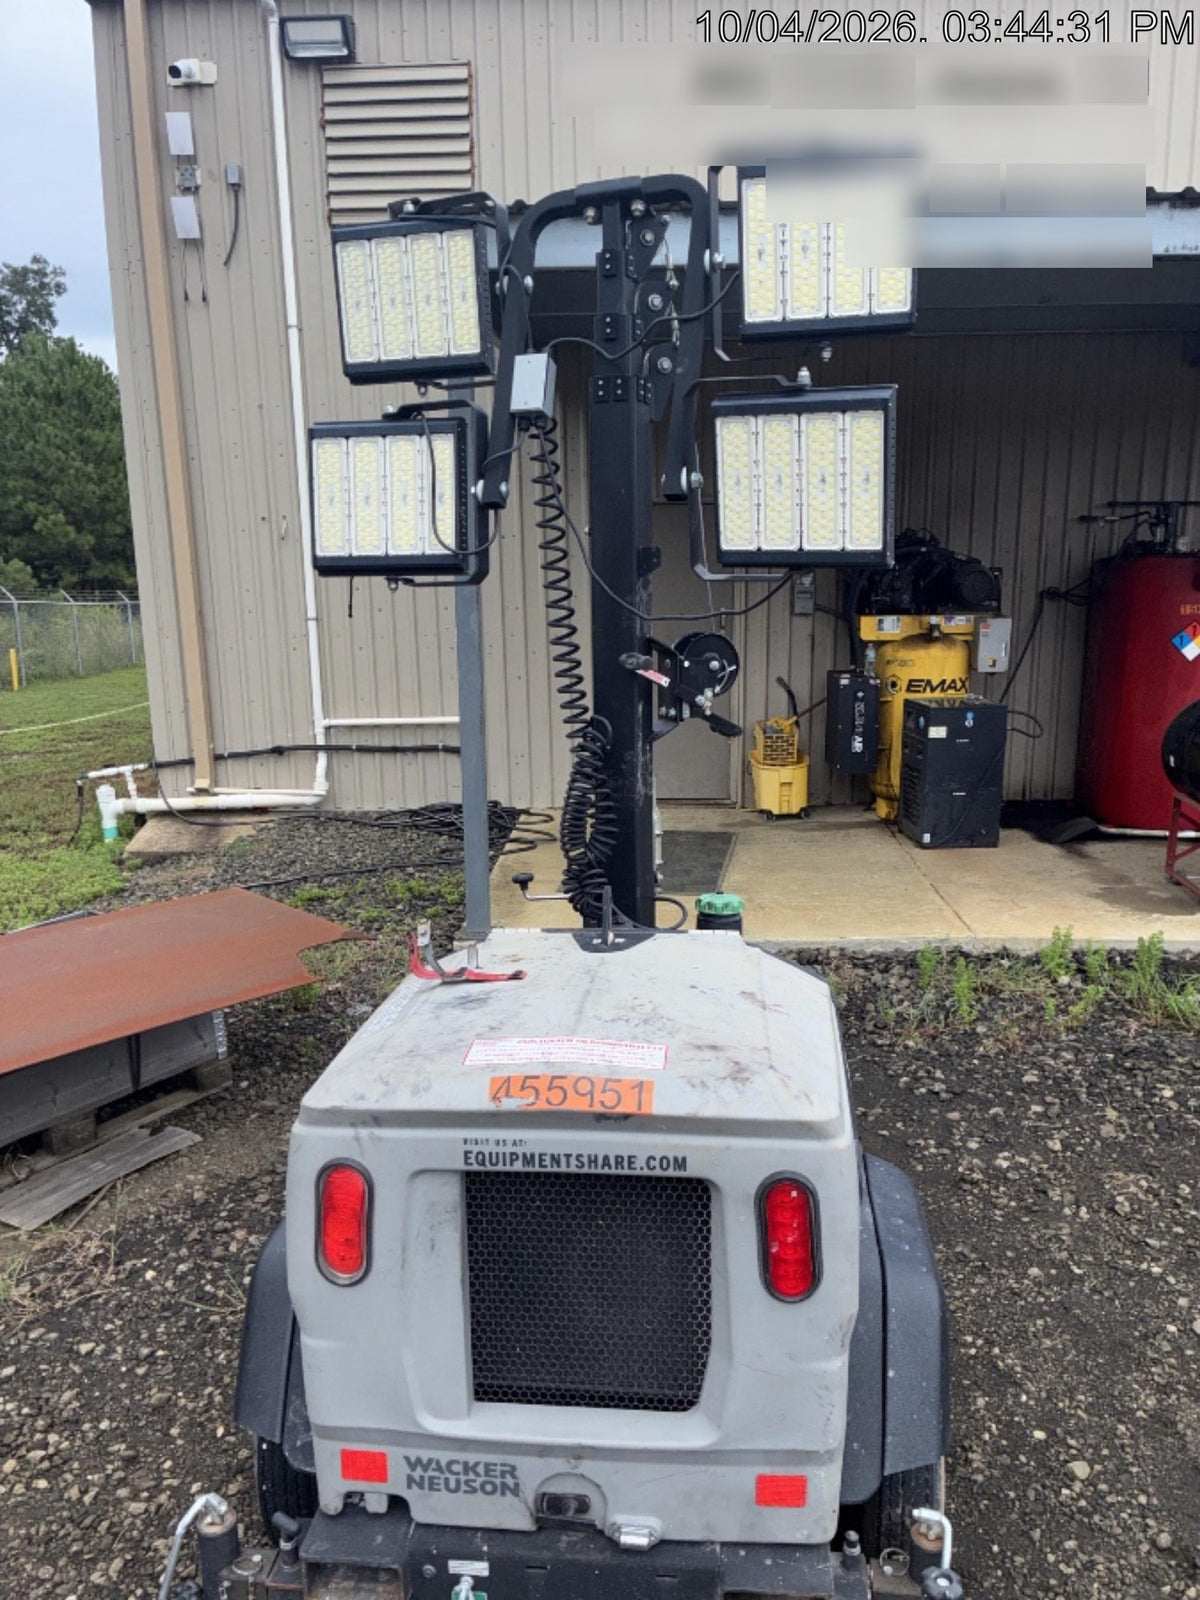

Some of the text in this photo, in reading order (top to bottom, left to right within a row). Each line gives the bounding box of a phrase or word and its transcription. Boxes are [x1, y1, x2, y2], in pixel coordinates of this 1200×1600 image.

[905, 677, 968, 693] EMAX
[492, 1075, 644, 1111] 455951
[463, 1138, 489, 1146] VISIT
[463, 1150, 687, 1172] EQUIPMENTSHARE.COM
[403, 1456, 518, 1480] WACKER
[406, 1474, 520, 1497] NEUSON
